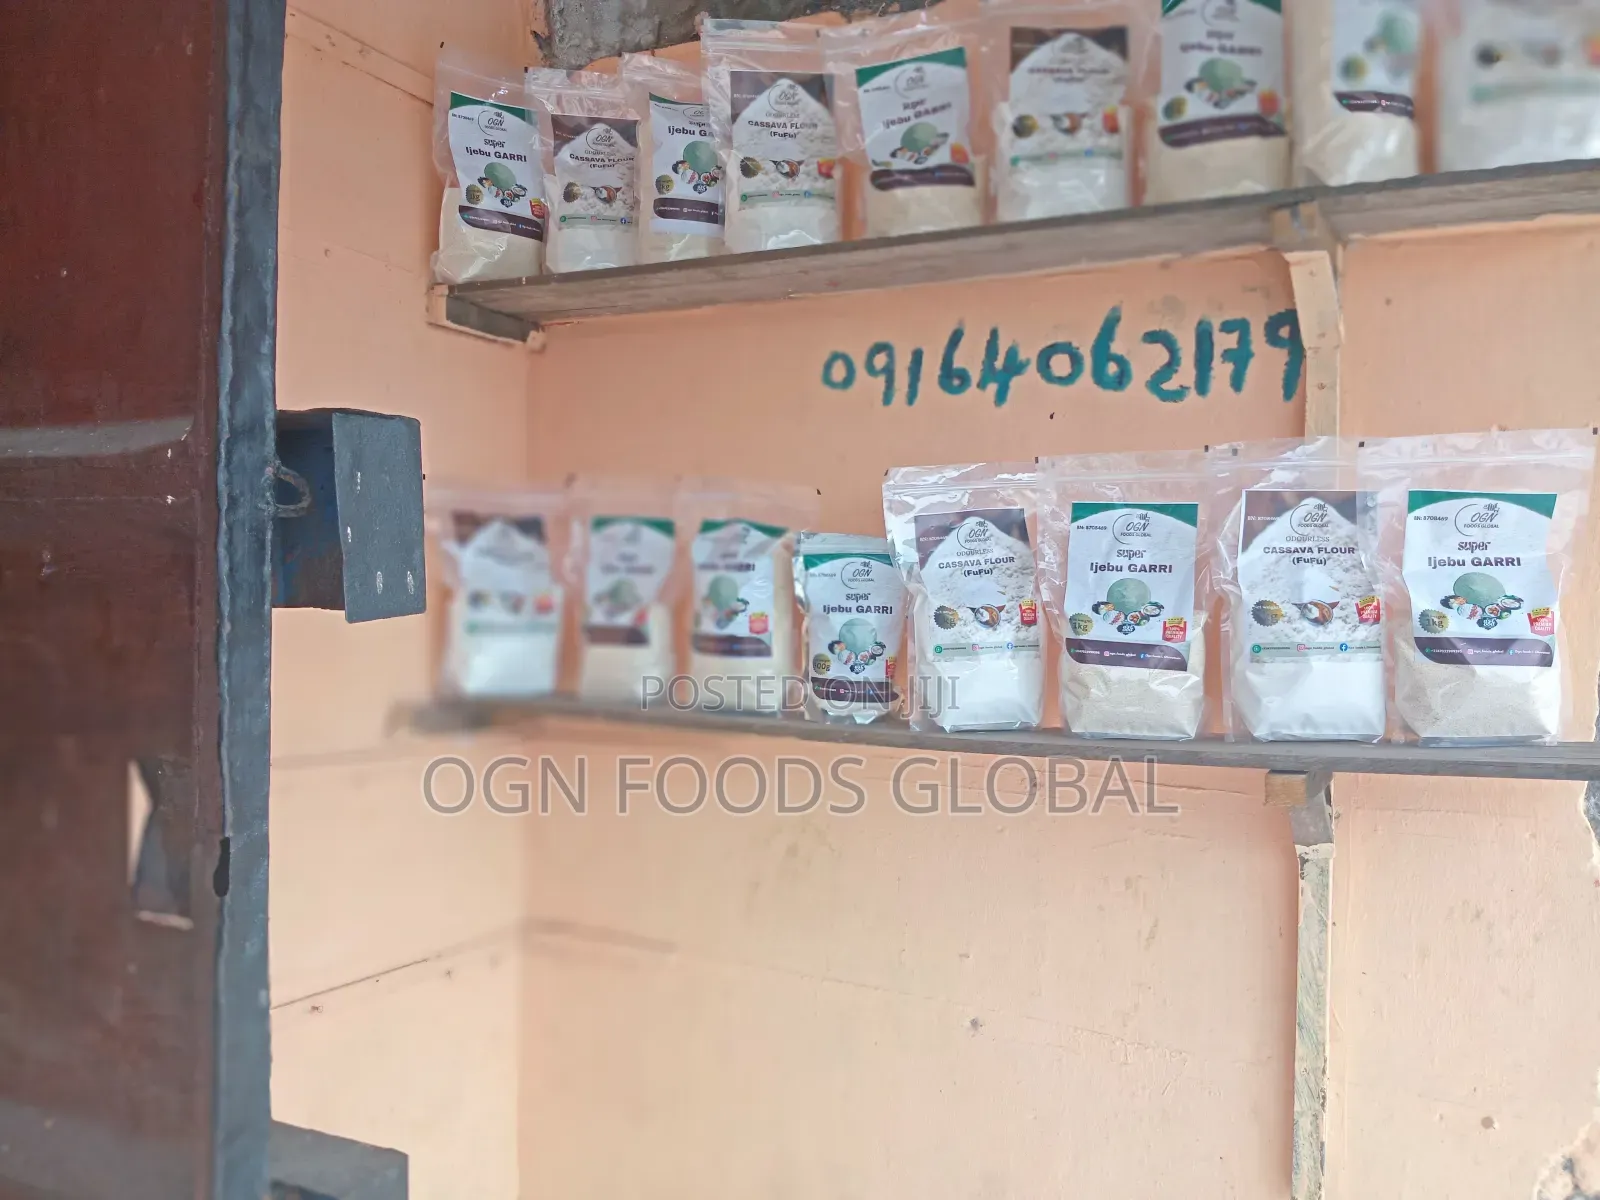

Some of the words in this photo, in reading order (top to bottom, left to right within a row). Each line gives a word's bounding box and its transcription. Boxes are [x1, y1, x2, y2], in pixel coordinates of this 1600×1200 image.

[747, 120, 788, 129] CASSAVA
[668, 126, 696, 136] Ijebu
[465, 146, 491, 157] Ijebu
[494, 151, 527, 162] GARRI
[569, 153, 606, 163] CASSAVA
[1303, 512, 1328, 523] OGN
[1470, 512, 1499, 523] OGN
[1125, 521, 1150, 532] OGN
[968, 528, 989, 539] OGN
[1263, 546, 1314, 554] CASSAVA
[1317, 546, 1355, 554] FLOUR
[1457, 541, 1491, 554] super
[1116, 549, 1147, 561] super
[938, 558, 981, 570] CASSAVA
[984, 556, 1015, 565] FLOUR
[1292, 556, 1327, 566] (FuFu)
[1427, 556, 1466, 570] Ijebu
[1470, 556, 1522, 567] GARRI
[852, 568, 873, 578] OGN
[963, 567, 994, 578] (FuFu)
[1090, 562, 1123, 574] Ijebu
[1127, 563, 1173, 574] GARRI
[823, 604, 852, 615] Ijebu
[856, 605, 893, 615] GARRI
